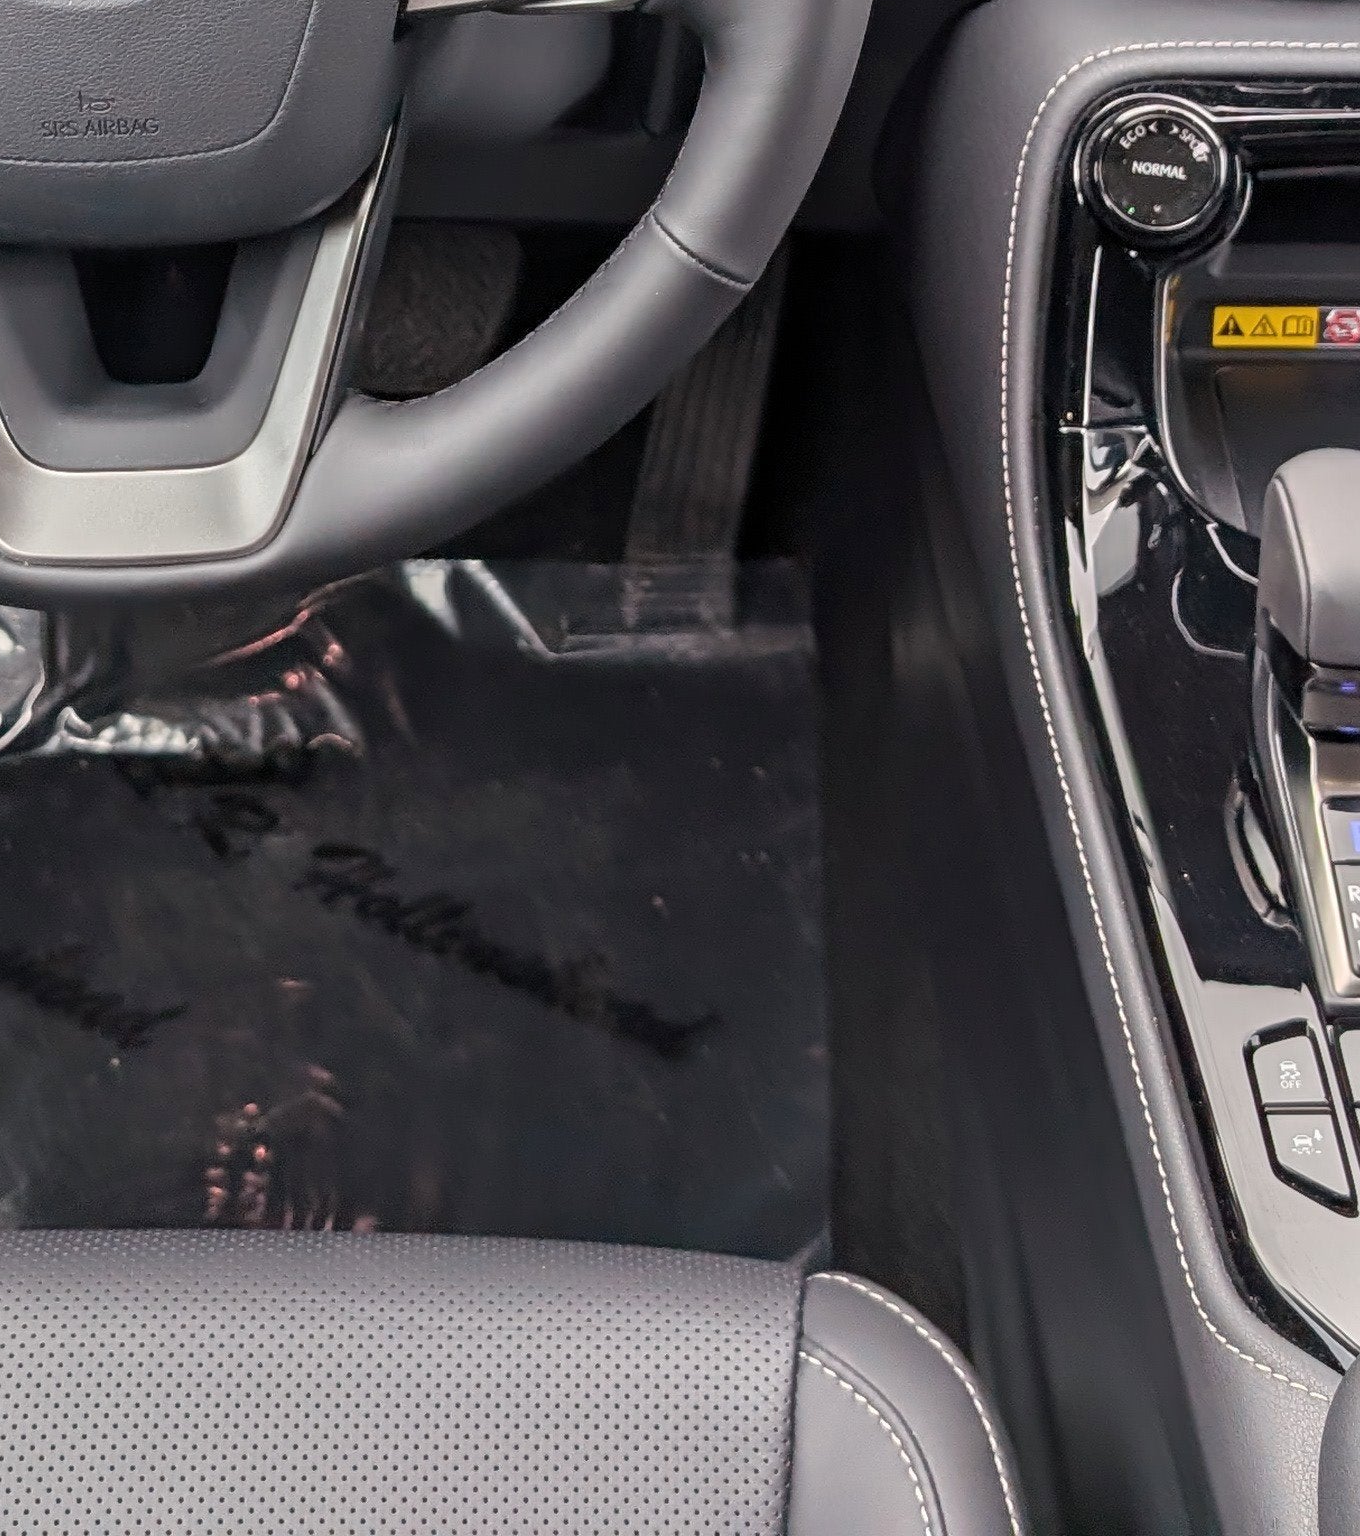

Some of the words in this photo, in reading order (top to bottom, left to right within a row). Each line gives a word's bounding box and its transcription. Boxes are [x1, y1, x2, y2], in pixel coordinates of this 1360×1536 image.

[41, 119, 79, 138] SRS
[82, 118, 160, 137] AIRBAG
[1119, 125, 1147, 150] ECO
[1131, 161, 1187, 181] NORMAL
[1280, 1080, 1302, 1089] OFF
